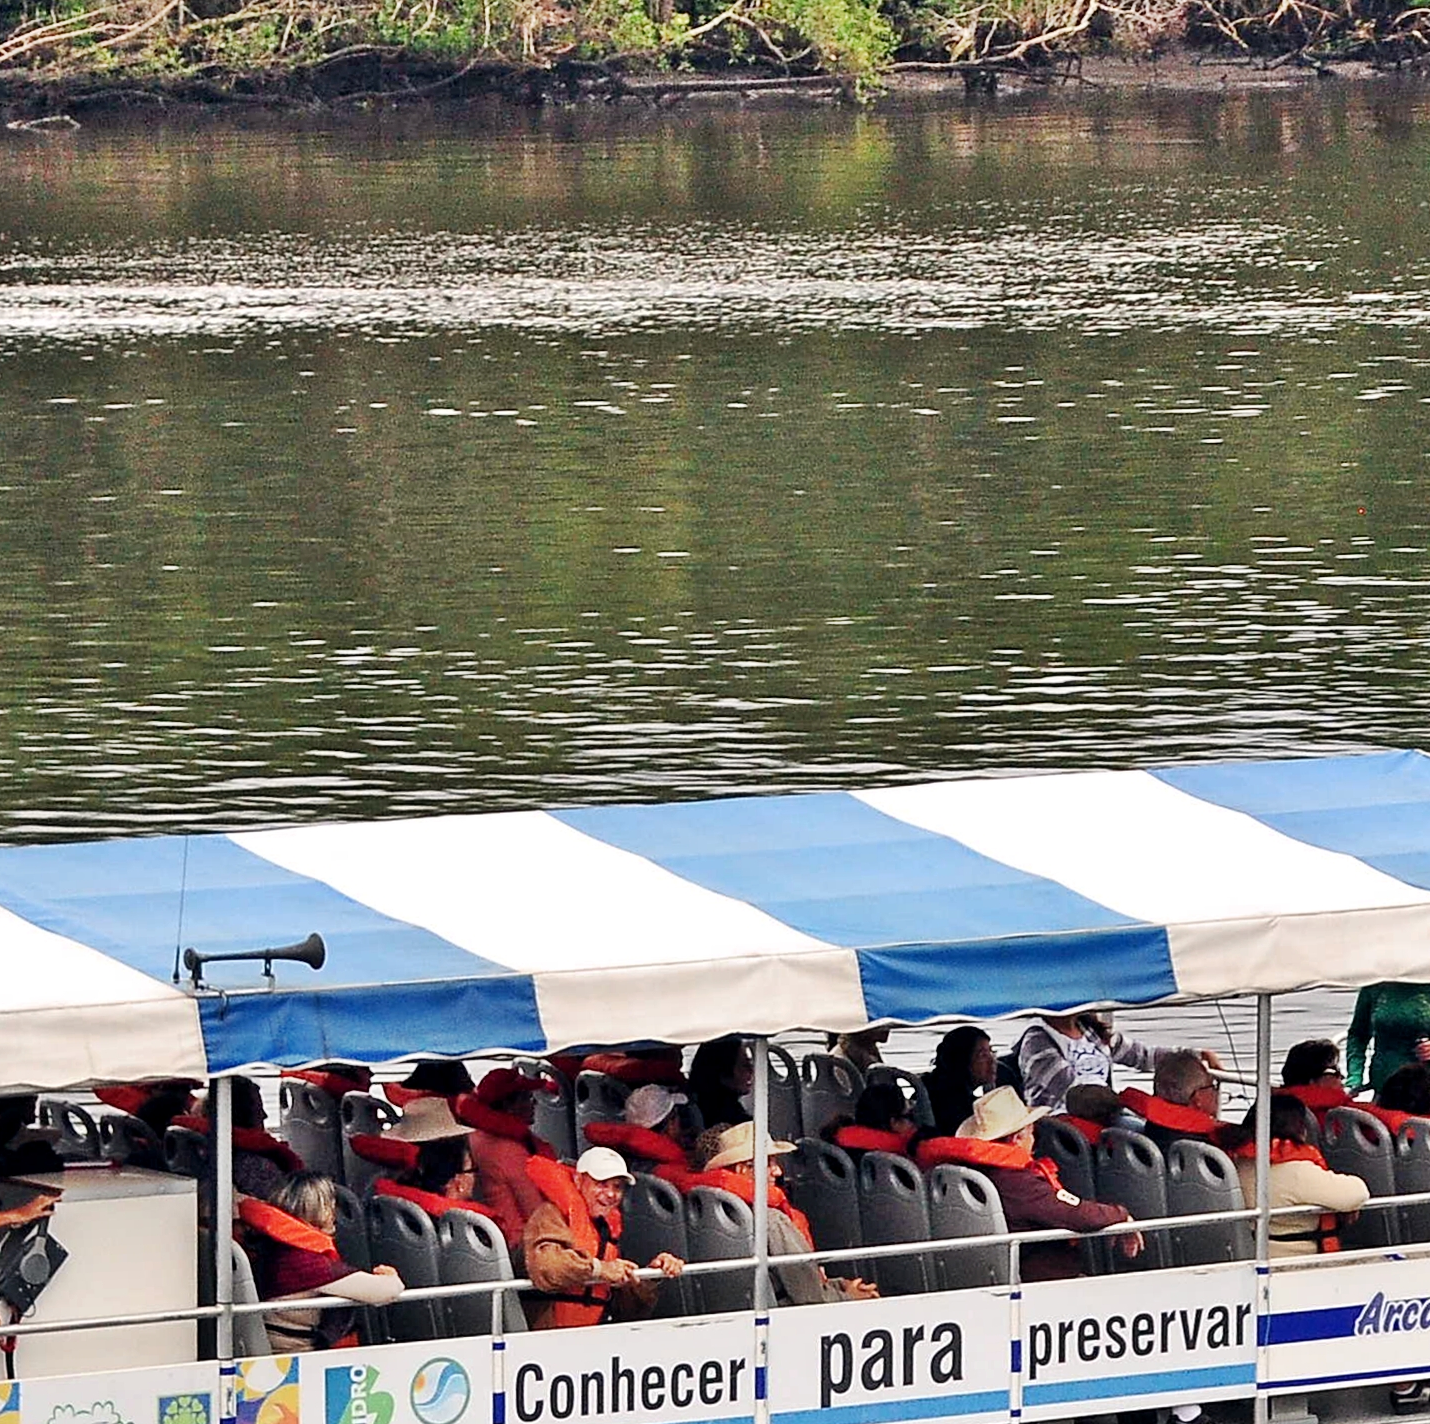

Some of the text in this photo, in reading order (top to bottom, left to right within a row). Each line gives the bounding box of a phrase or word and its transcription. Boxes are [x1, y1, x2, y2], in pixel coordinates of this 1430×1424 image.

[819, 1321, 965, 1410] para
[1029, 1301, 1251, 1379] preservar
[515, 1356, 747, 1423] Conhecer
